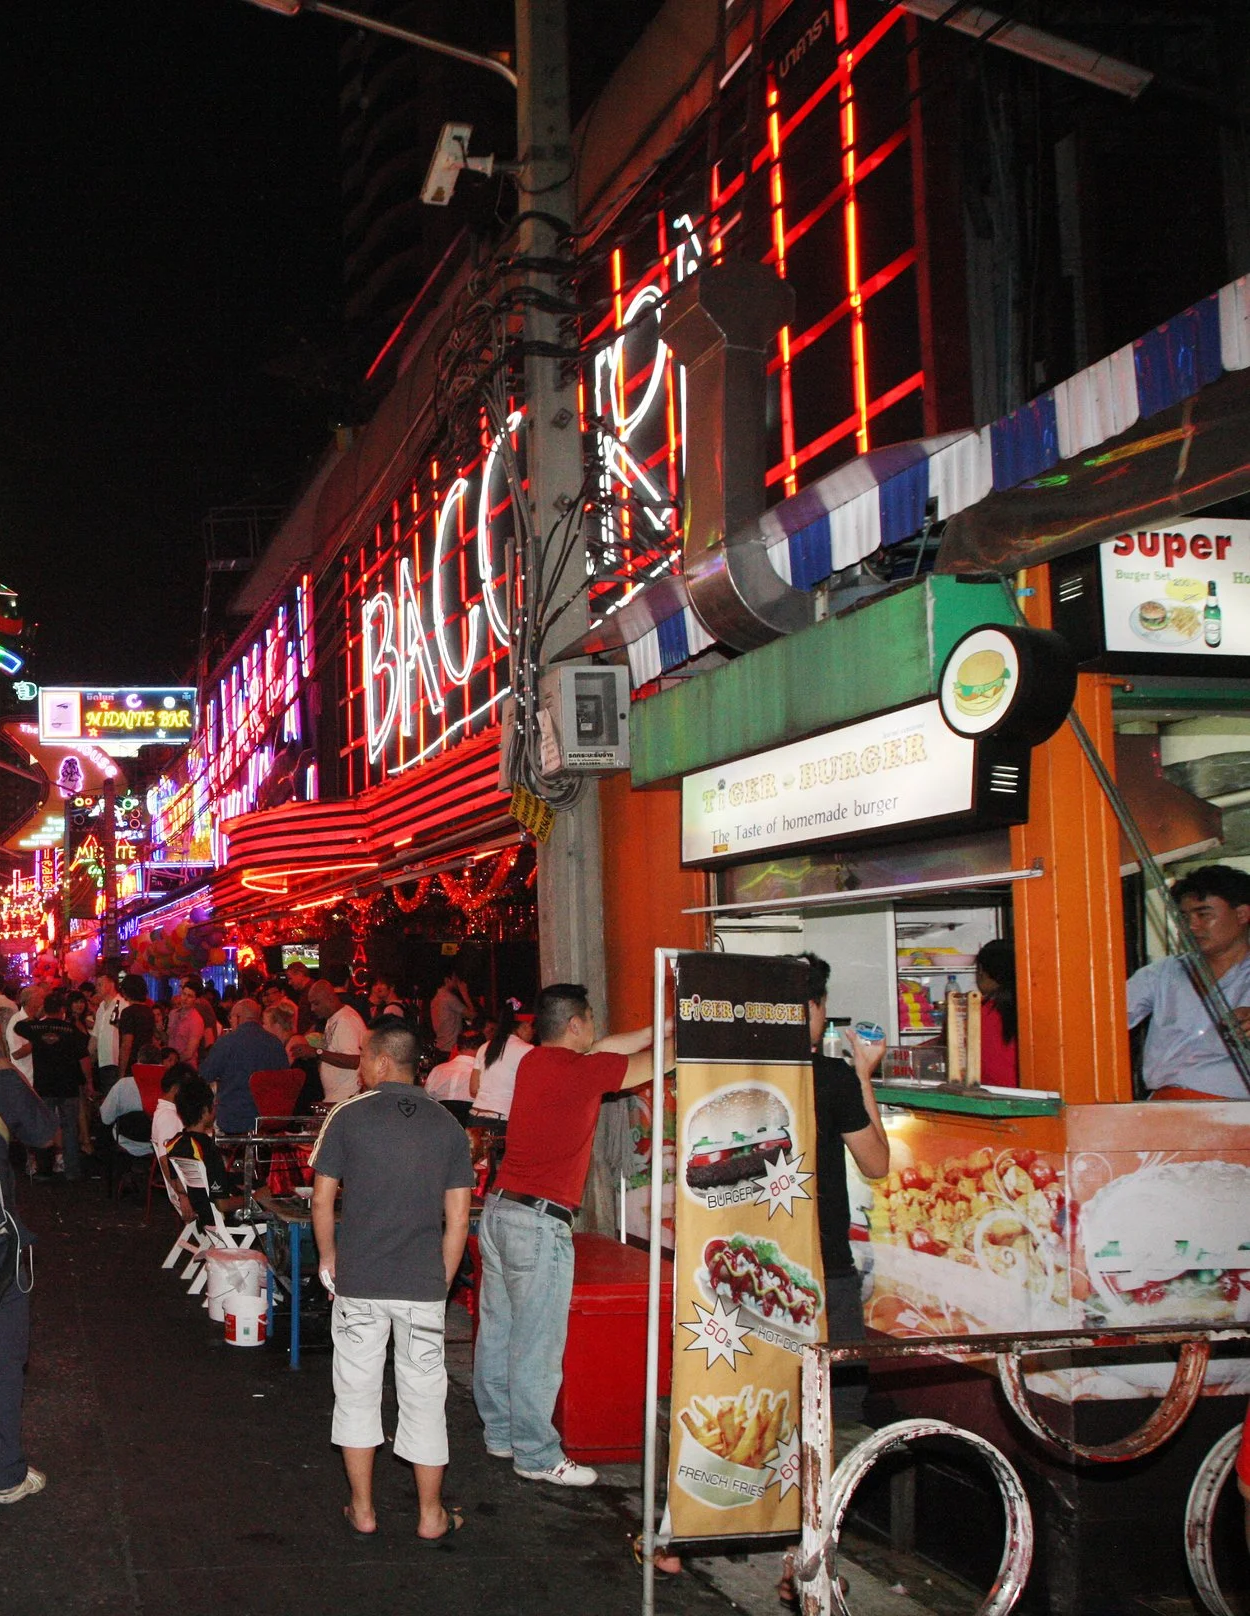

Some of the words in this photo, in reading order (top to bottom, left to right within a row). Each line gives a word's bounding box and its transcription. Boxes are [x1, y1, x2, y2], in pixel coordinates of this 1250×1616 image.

[1113, 531, 1232, 568] Super
[1115, 570, 1151, 582] Burger
[1154, 571, 1171, 581] Set
[19, 724, 38, 736] The
[85, 709, 155, 730] MIDNITE
[157, 709, 192, 728] BAR
[800, 733, 928, 790] BURGER
[711, 829, 730, 845] The
[734, 823, 762, 841] Taste
[766, 816, 779, 834] of
[782, 805, 848, 832] homemade
[854, 796, 899, 817] burger
[893, 1049, 910, 1060] TIP
[707, 1186, 754, 1209] BURGER
[780, 1453, 801, 1480] 60
[677, 1465, 729, 1488] FRENCH
[732, 1479, 766, 1498] FRIES
